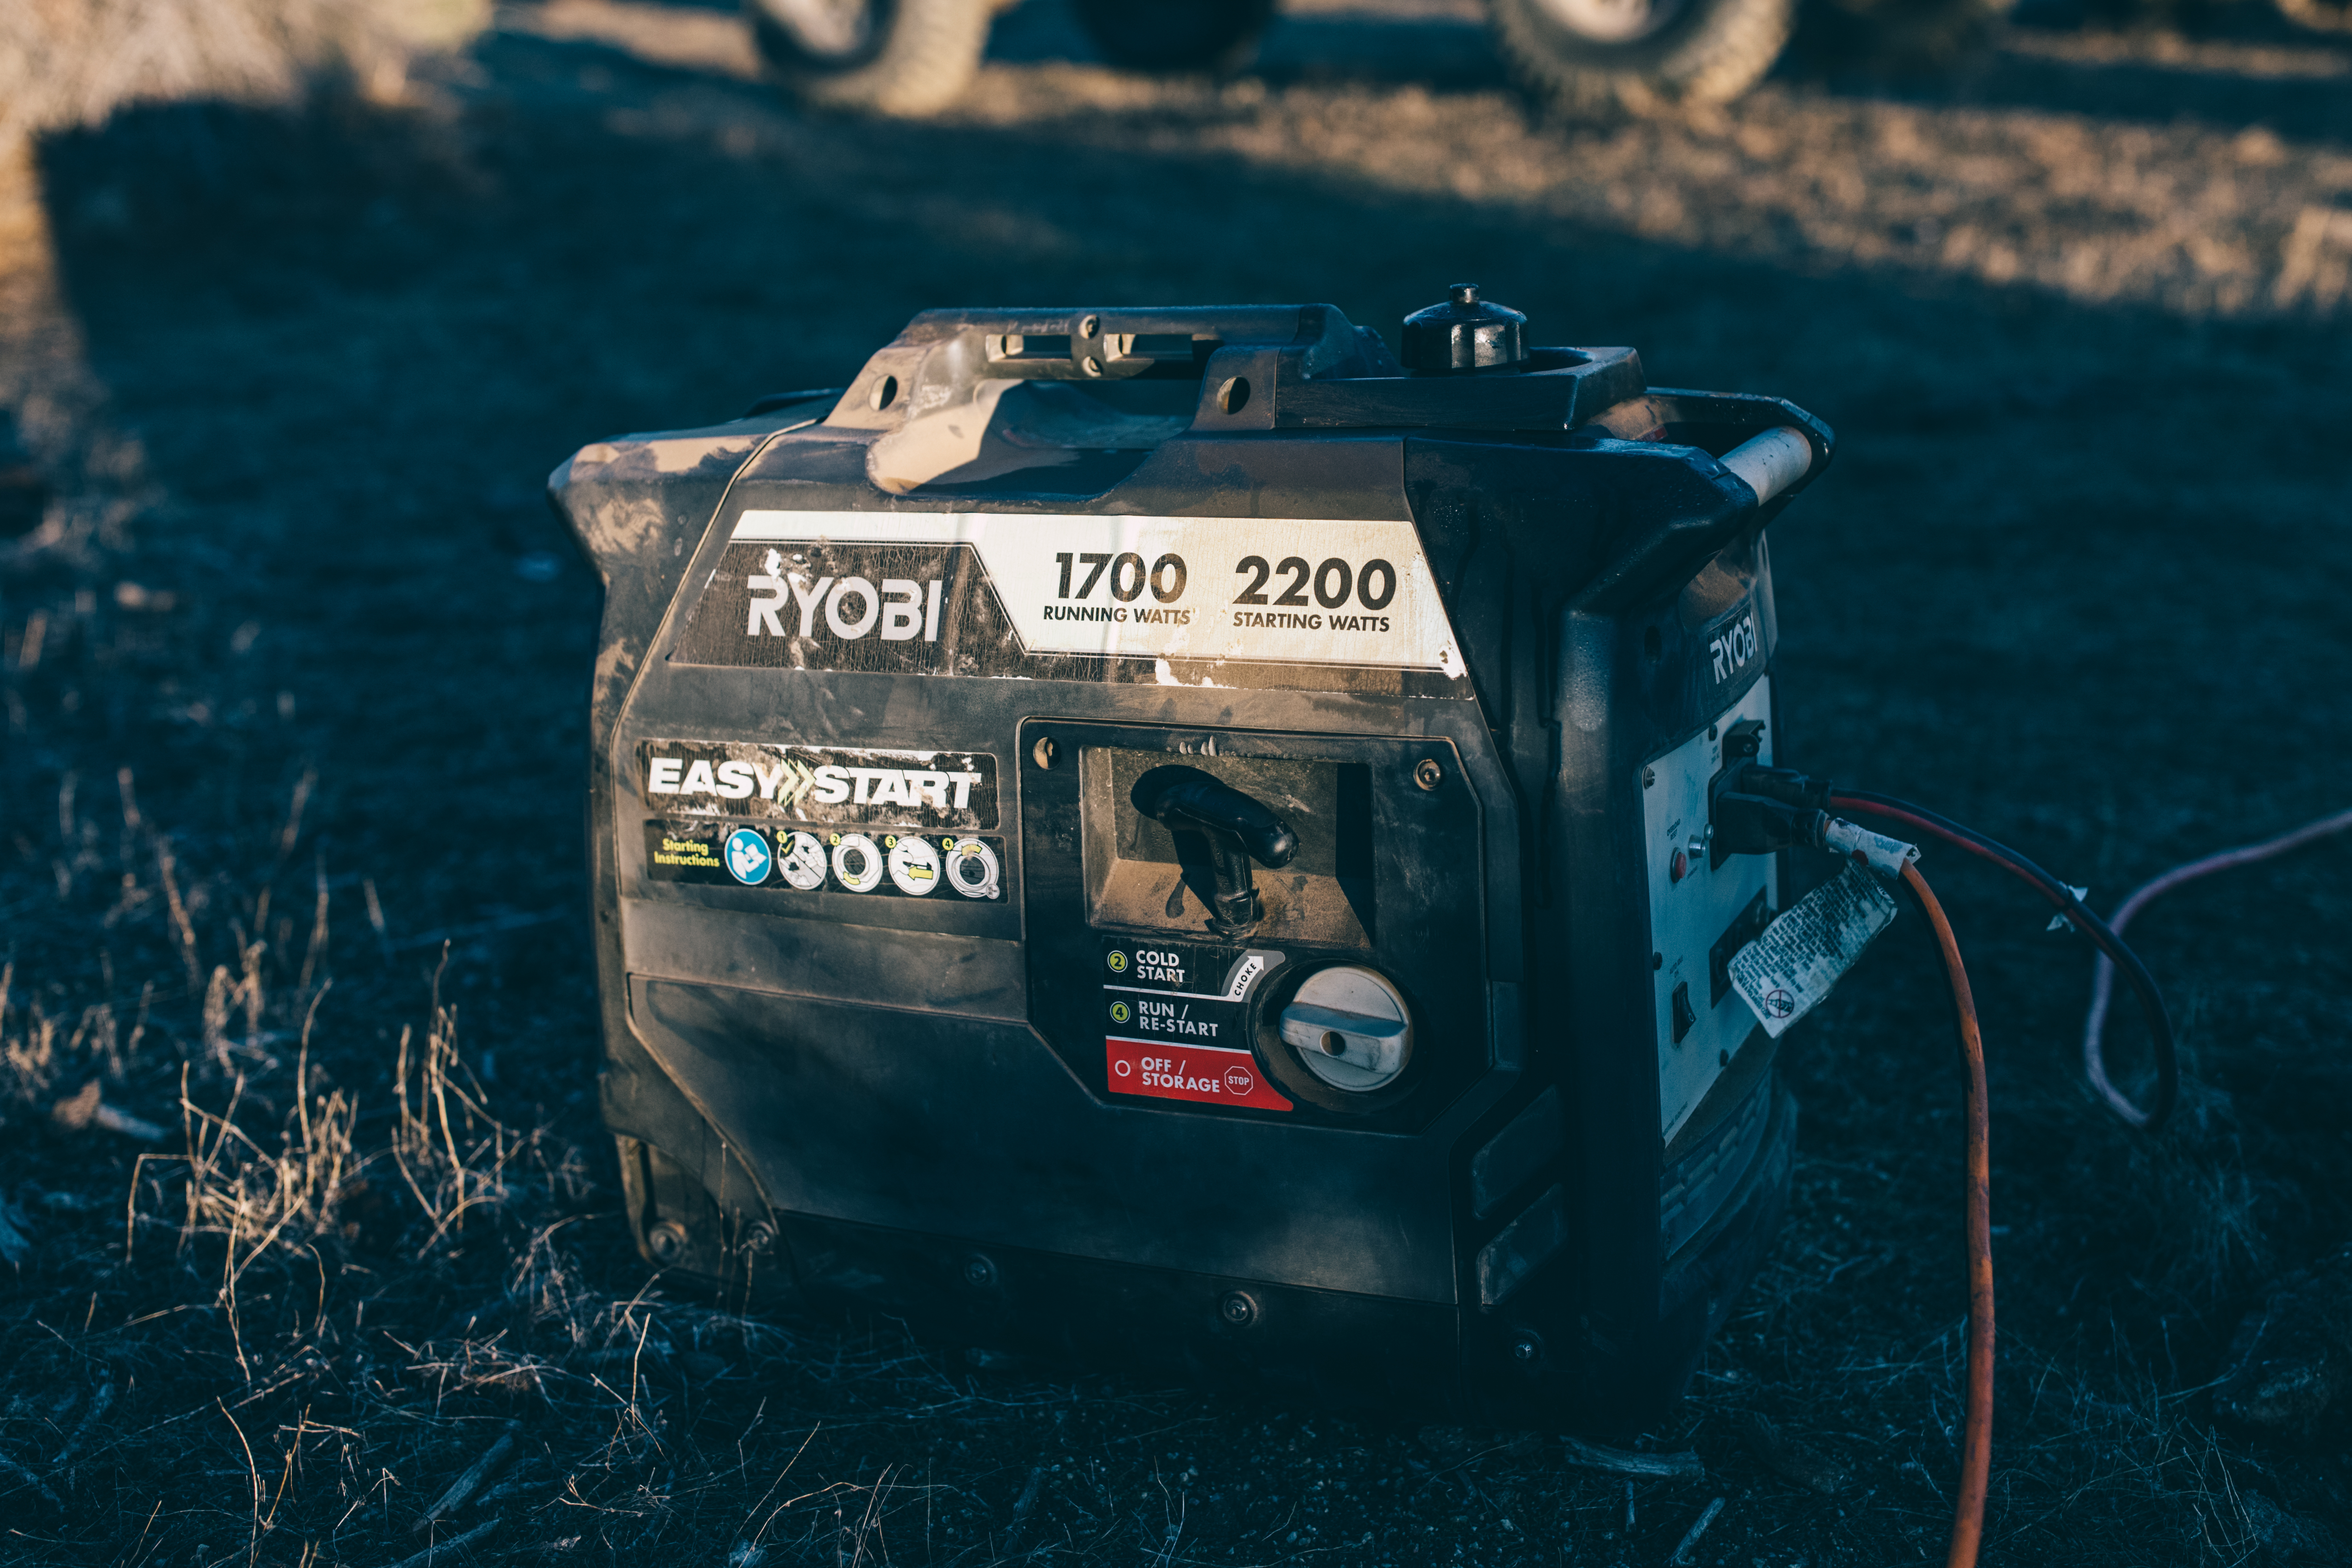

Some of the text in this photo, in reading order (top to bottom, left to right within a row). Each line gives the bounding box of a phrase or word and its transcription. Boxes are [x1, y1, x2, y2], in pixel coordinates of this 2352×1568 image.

[1055, 552, 1397, 611] 1700 2200
[747, 574, 942, 642] RYOBI
[1043, 605, 1191, 626] RUNNING WATTS
[1233, 611, 1390, 633] STARTING WATTS
[1710, 612, 1758, 685] RYOBI
[648, 757, 982, 809] EASY START
[663, 838, 709, 856] Starting
[654, 851, 720, 867] Instructions
[1114, 956, 1122, 967] 2
[1136, 950, 1179, 967] COLD
[1137, 965, 1185, 982] START
[1234, 963, 1257, 996] CHOKE
[1115, 1007, 1124, 1018] 4
[1138, 1001, 1189, 1019] RUN /
[1139, 1016, 1218, 1037] RE-START
[1141, 1057, 1186, 1075] OFF /
[1142, 1072, 1220, 1093] STORAGE
[1228, 1075, 1250, 1086] STOP
